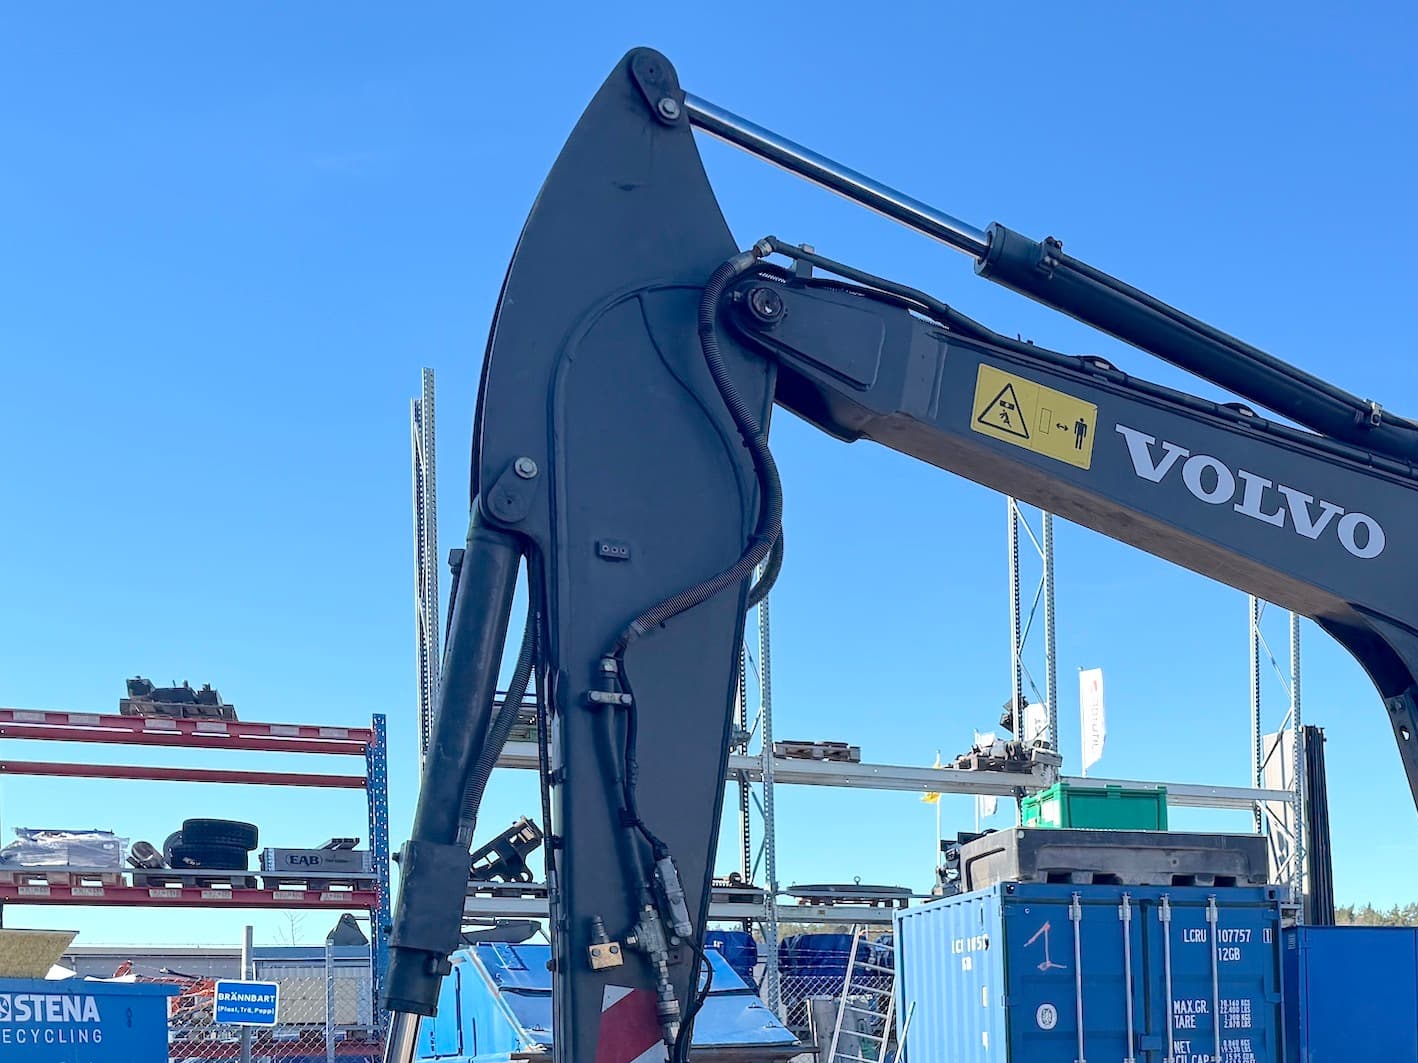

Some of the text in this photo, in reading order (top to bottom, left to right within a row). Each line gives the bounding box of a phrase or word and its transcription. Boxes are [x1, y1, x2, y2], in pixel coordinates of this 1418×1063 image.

[1115, 424, 1386, 559] VOLVO
[290, 855, 320, 866] EAB
[1183, 929, 1207, 943] LCRU
[1217, 929, 1251, 943] 107757
[1218, 947, 1240, 961] 12GB
[218, 991, 275, 1003] BRÄNNBART
[14, 994, 100, 1022] STENA
[1174, 1015, 1196, 1029] TARE
[1174, 1041, 1191, 1054] NET
